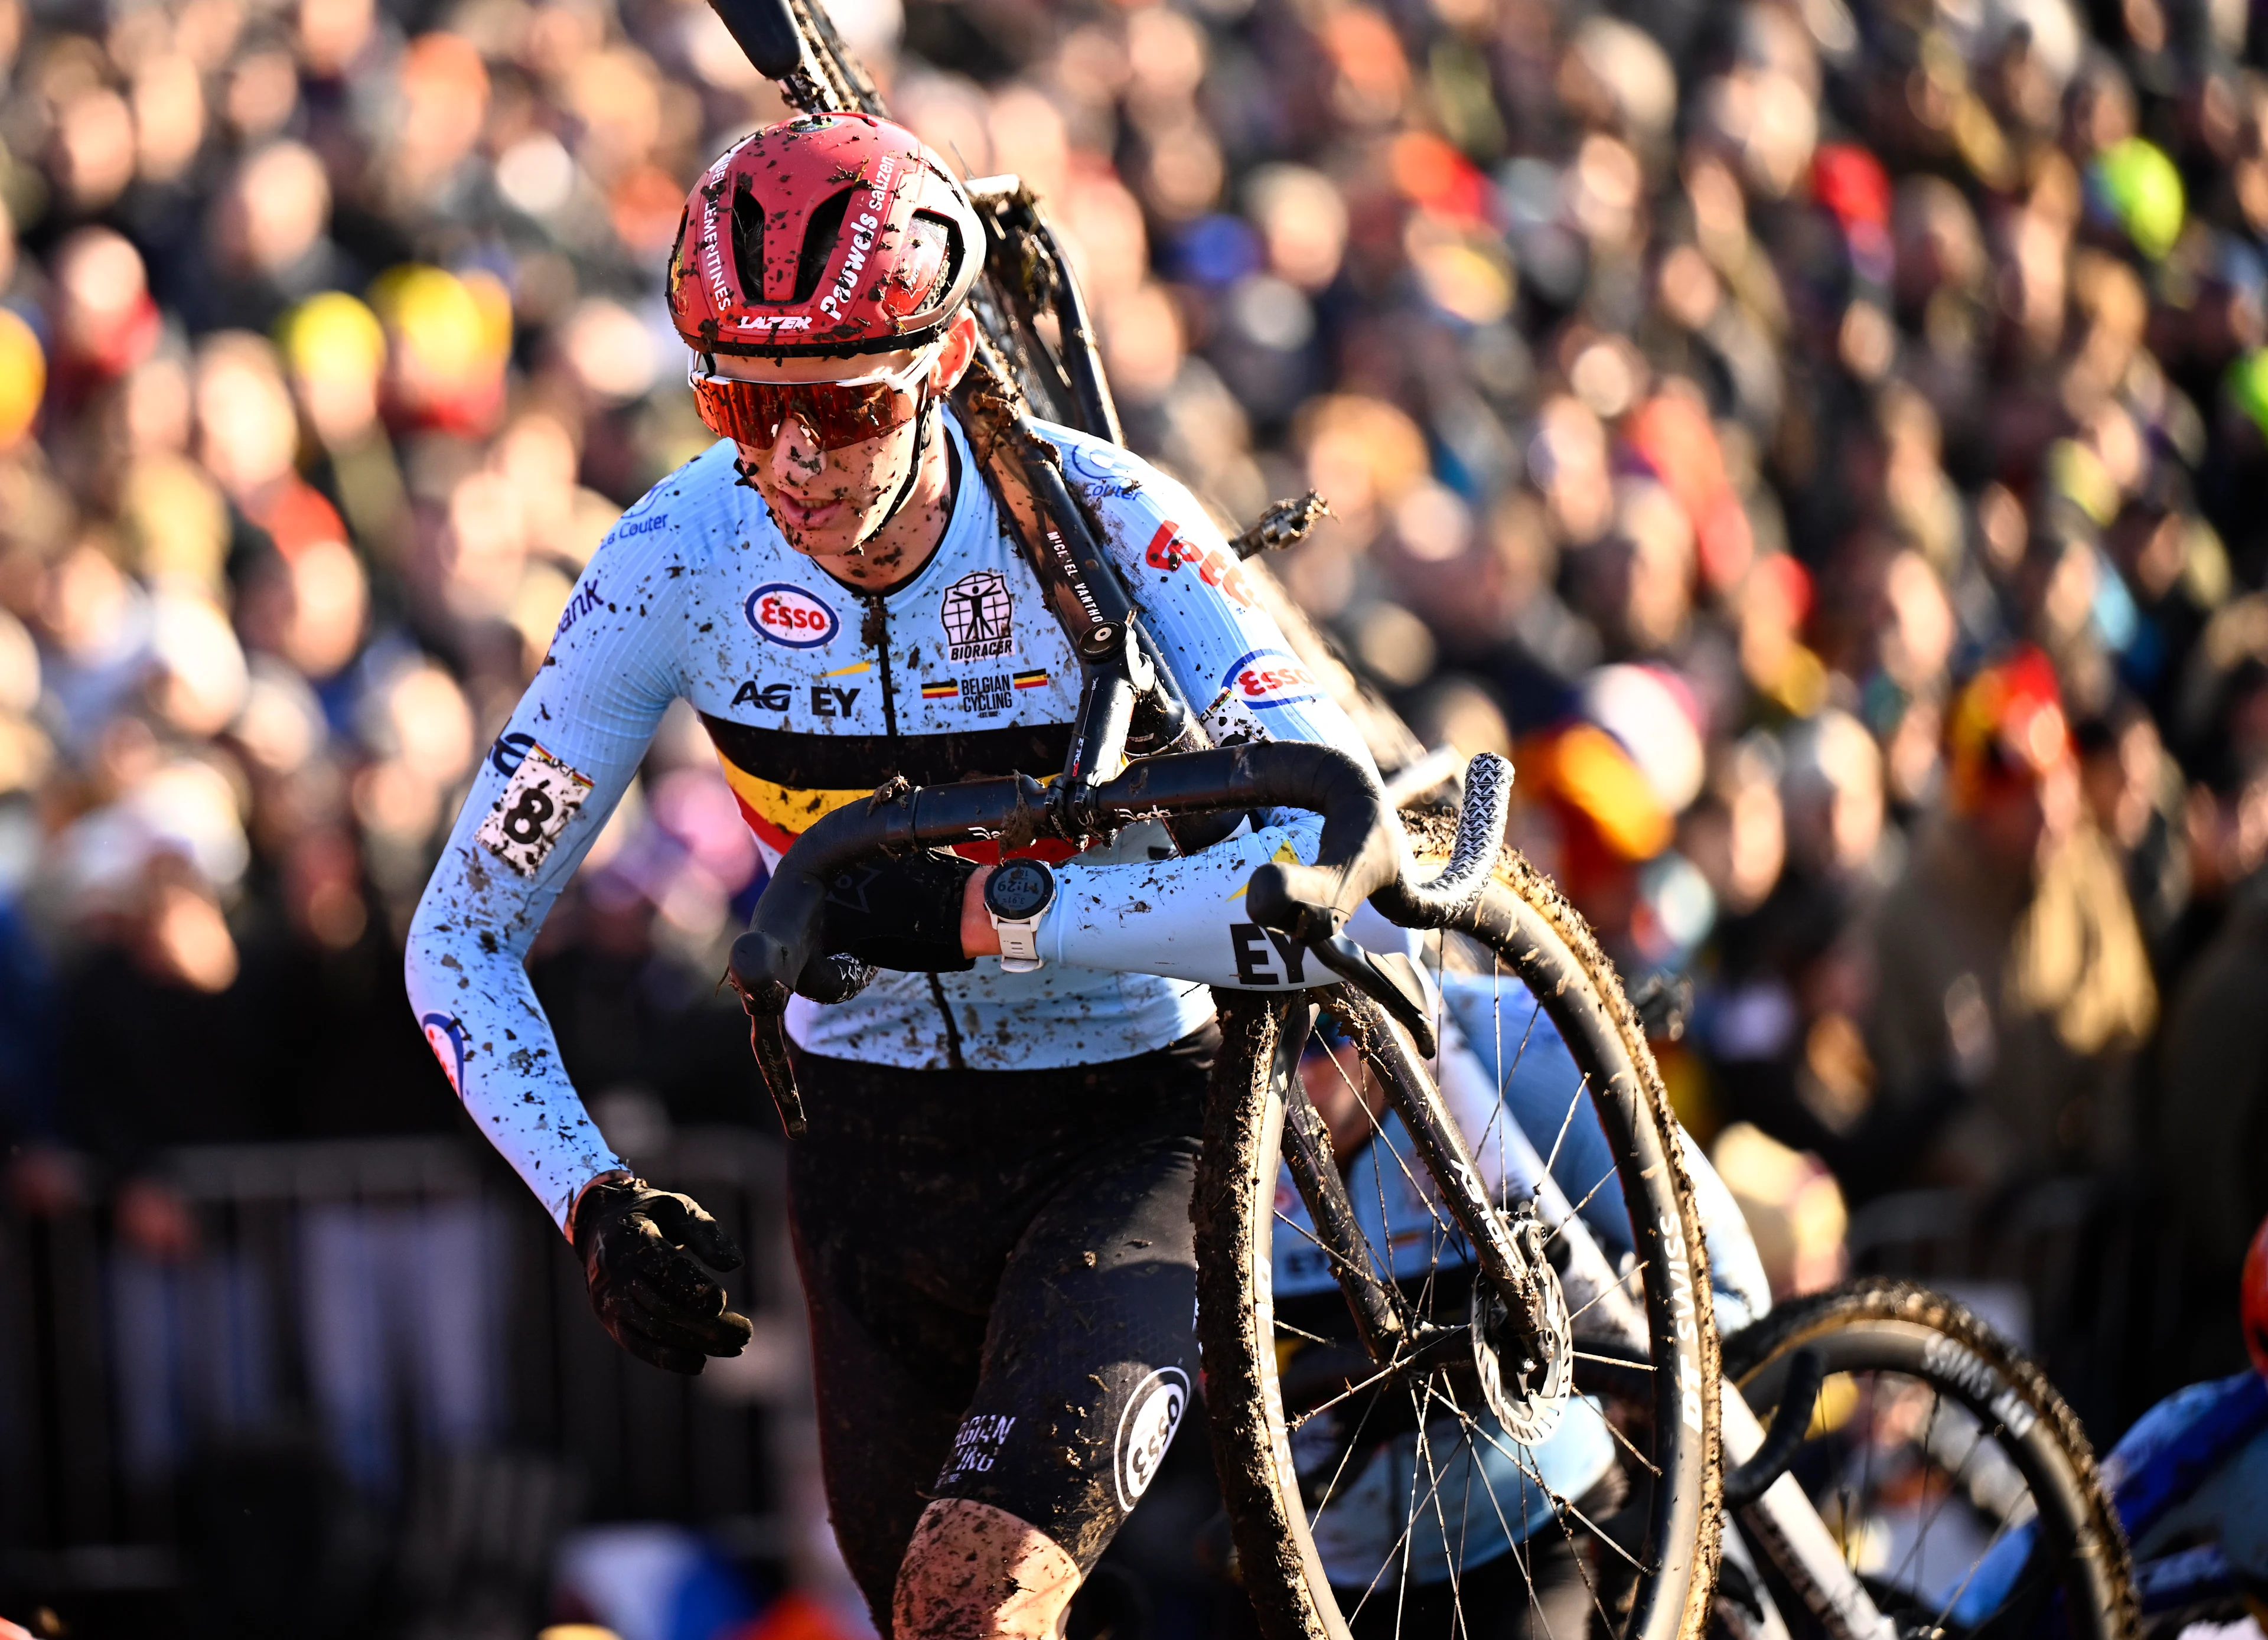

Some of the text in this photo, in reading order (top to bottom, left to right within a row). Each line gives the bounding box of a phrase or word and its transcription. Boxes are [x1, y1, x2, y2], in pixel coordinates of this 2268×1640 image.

[703, 194, 731, 311] LEMENTINES
[820, 155, 896, 321] Pauwels sauzen
[737, 315, 813, 330] LAZER
[618, 512, 669, 539] Couter
[1074, 582, 1104, 623] VANTHO
[951, 639, 1012, 661] BIORACER
[731, 680, 793, 712] AG
[962, 674, 1011, 696] BELGIAN
[811, 686, 861, 717] EY
[963, 692, 1012, 713] CYCLING
[1198, 709, 1211, 726] CI
[503, 787, 553, 845] 8
[1229, 923, 1307, 985] EY
[1659, 1212, 1703, 1434] DT SWISS
[1262, 1355, 1297, 1488] SWISS
